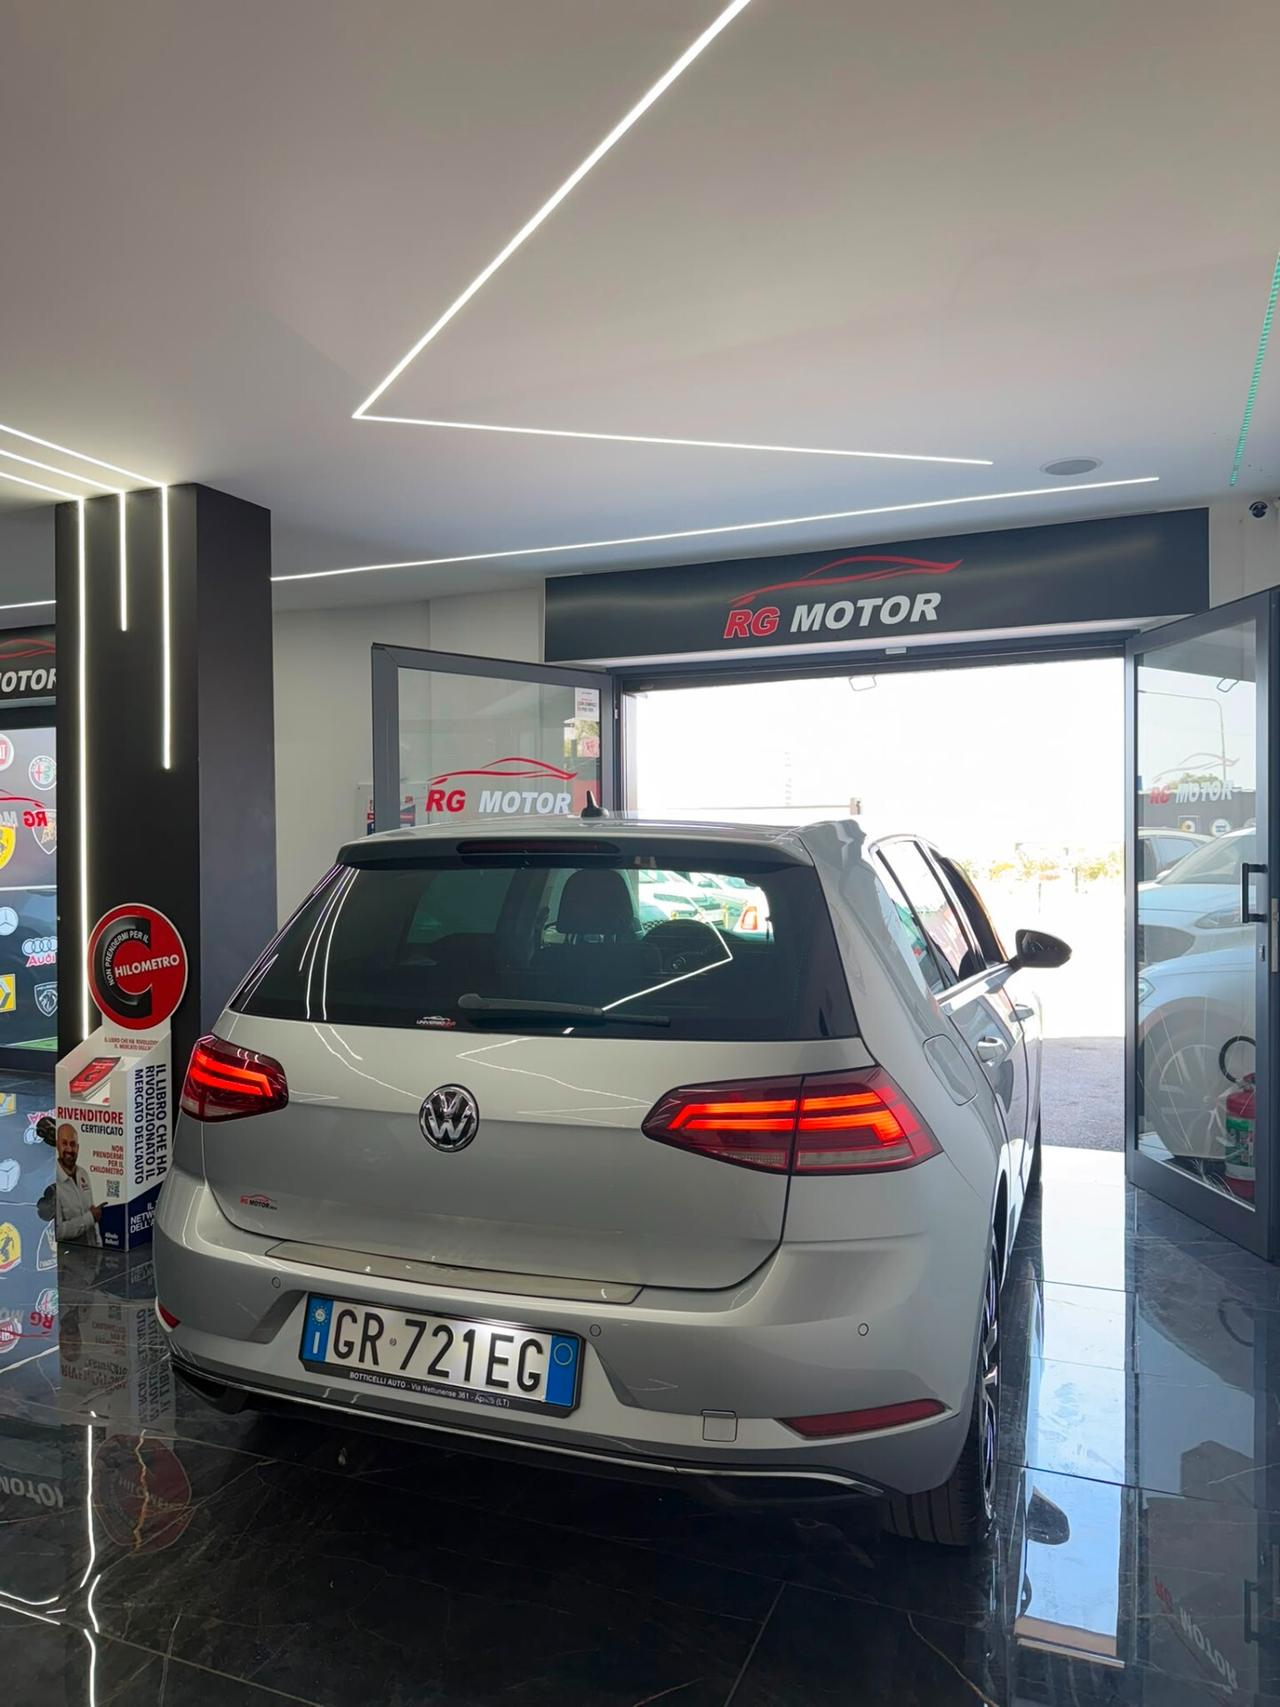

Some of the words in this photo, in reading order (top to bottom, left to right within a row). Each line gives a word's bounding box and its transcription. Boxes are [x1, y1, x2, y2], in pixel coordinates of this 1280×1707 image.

[723, 606, 780, 638] RG
[790, 592, 942, 632] MOTOR
[0, 668, 56, 693] OTOR
[425, 789, 466, 813] RG
[478, 790, 572, 815] MOTOR
[1175, 780, 1233, 803] MOTOR
[129, 930, 143, 939] PER
[142, 934, 149, 943] IL
[104, 931, 129, 967] PRENDERMI
[104, 968, 115, 987] NON
[156, 1064, 166, 1077] IL
[135, 1069, 144, 1123] MERCATO
[156, 1079, 167, 1121] LIBRO
[57, 1106, 124, 1125] RIVENDITORE
[145, 1065, 155, 1166] RIVOLUZIONATO
[80, 1123, 124, 1137] CERTIFICATO
[156, 1124, 167, 1152] CHE
[135, 1126, 144, 1185] DELL'AUTO
[156, 1155, 167, 1176] HA
[145, 1168, 155, 1181] IL
[130, 1211, 155, 1224] NETW
[130, 1219, 155, 1234] DELL'A
[333, 1308, 385, 1366] GR
[400, 1318, 544, 1393] 721EG
[349, 1371, 387, 1385] BOTTICELLI
[387, 1379, 406, 1388] AUTO
[411, 1383, 421, 1391] Via
